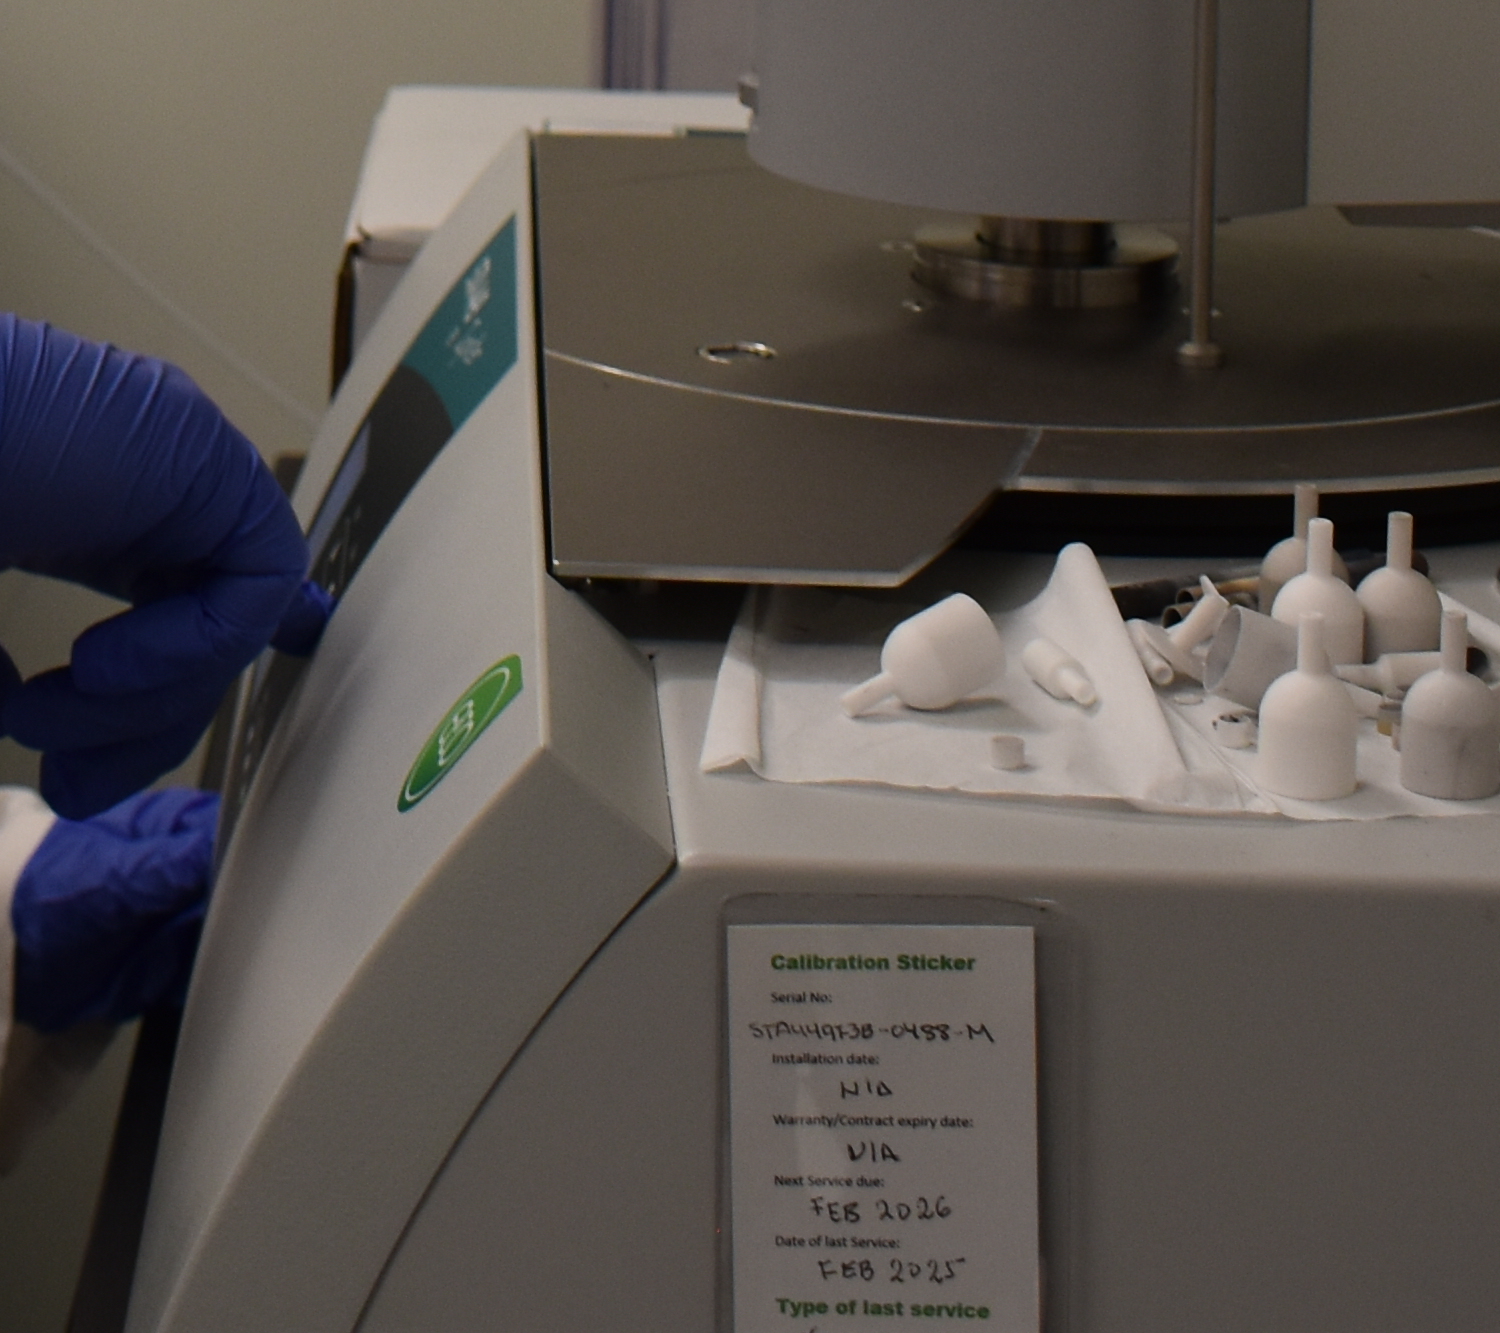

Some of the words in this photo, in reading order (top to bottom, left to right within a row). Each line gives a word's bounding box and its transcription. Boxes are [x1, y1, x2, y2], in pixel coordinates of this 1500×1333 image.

[771, 954, 889, 971] Calibration
[897, 954, 976, 972] Sticker
[771, 992, 806, 1004] Serial
[810, 992, 832, 1004] No:
[772, 1053, 843, 1065] Installation
[846, 1053, 880, 1066] date:
[773, 1114, 894, 1130] Warranty/Contract
[898, 1116, 937, 1130] expiry
[940, 1115, 974, 1128] date:
[775, 1176, 804, 1187] Next
[808, 1176, 854, 1188] Service
[856, 1176, 885, 1188] due:
[810, 1197, 860, 1222] FEB
[876, 1196, 952, 1220] 2026
[775, 1236, 805, 1248] Date
[808, 1236, 821, 1248] of
[824, 1236, 847, 1248] last
[851, 1236, 900, 1248] Service:
[818, 1260, 875, 1280] FEB
[889, 1257, 966, 1284] 2025
[776, 1298, 829, 1316] Type
[836, 1298, 859, 1315] of
[863, 1300, 906, 1317] last
[911, 1303, 990, 1319] service
